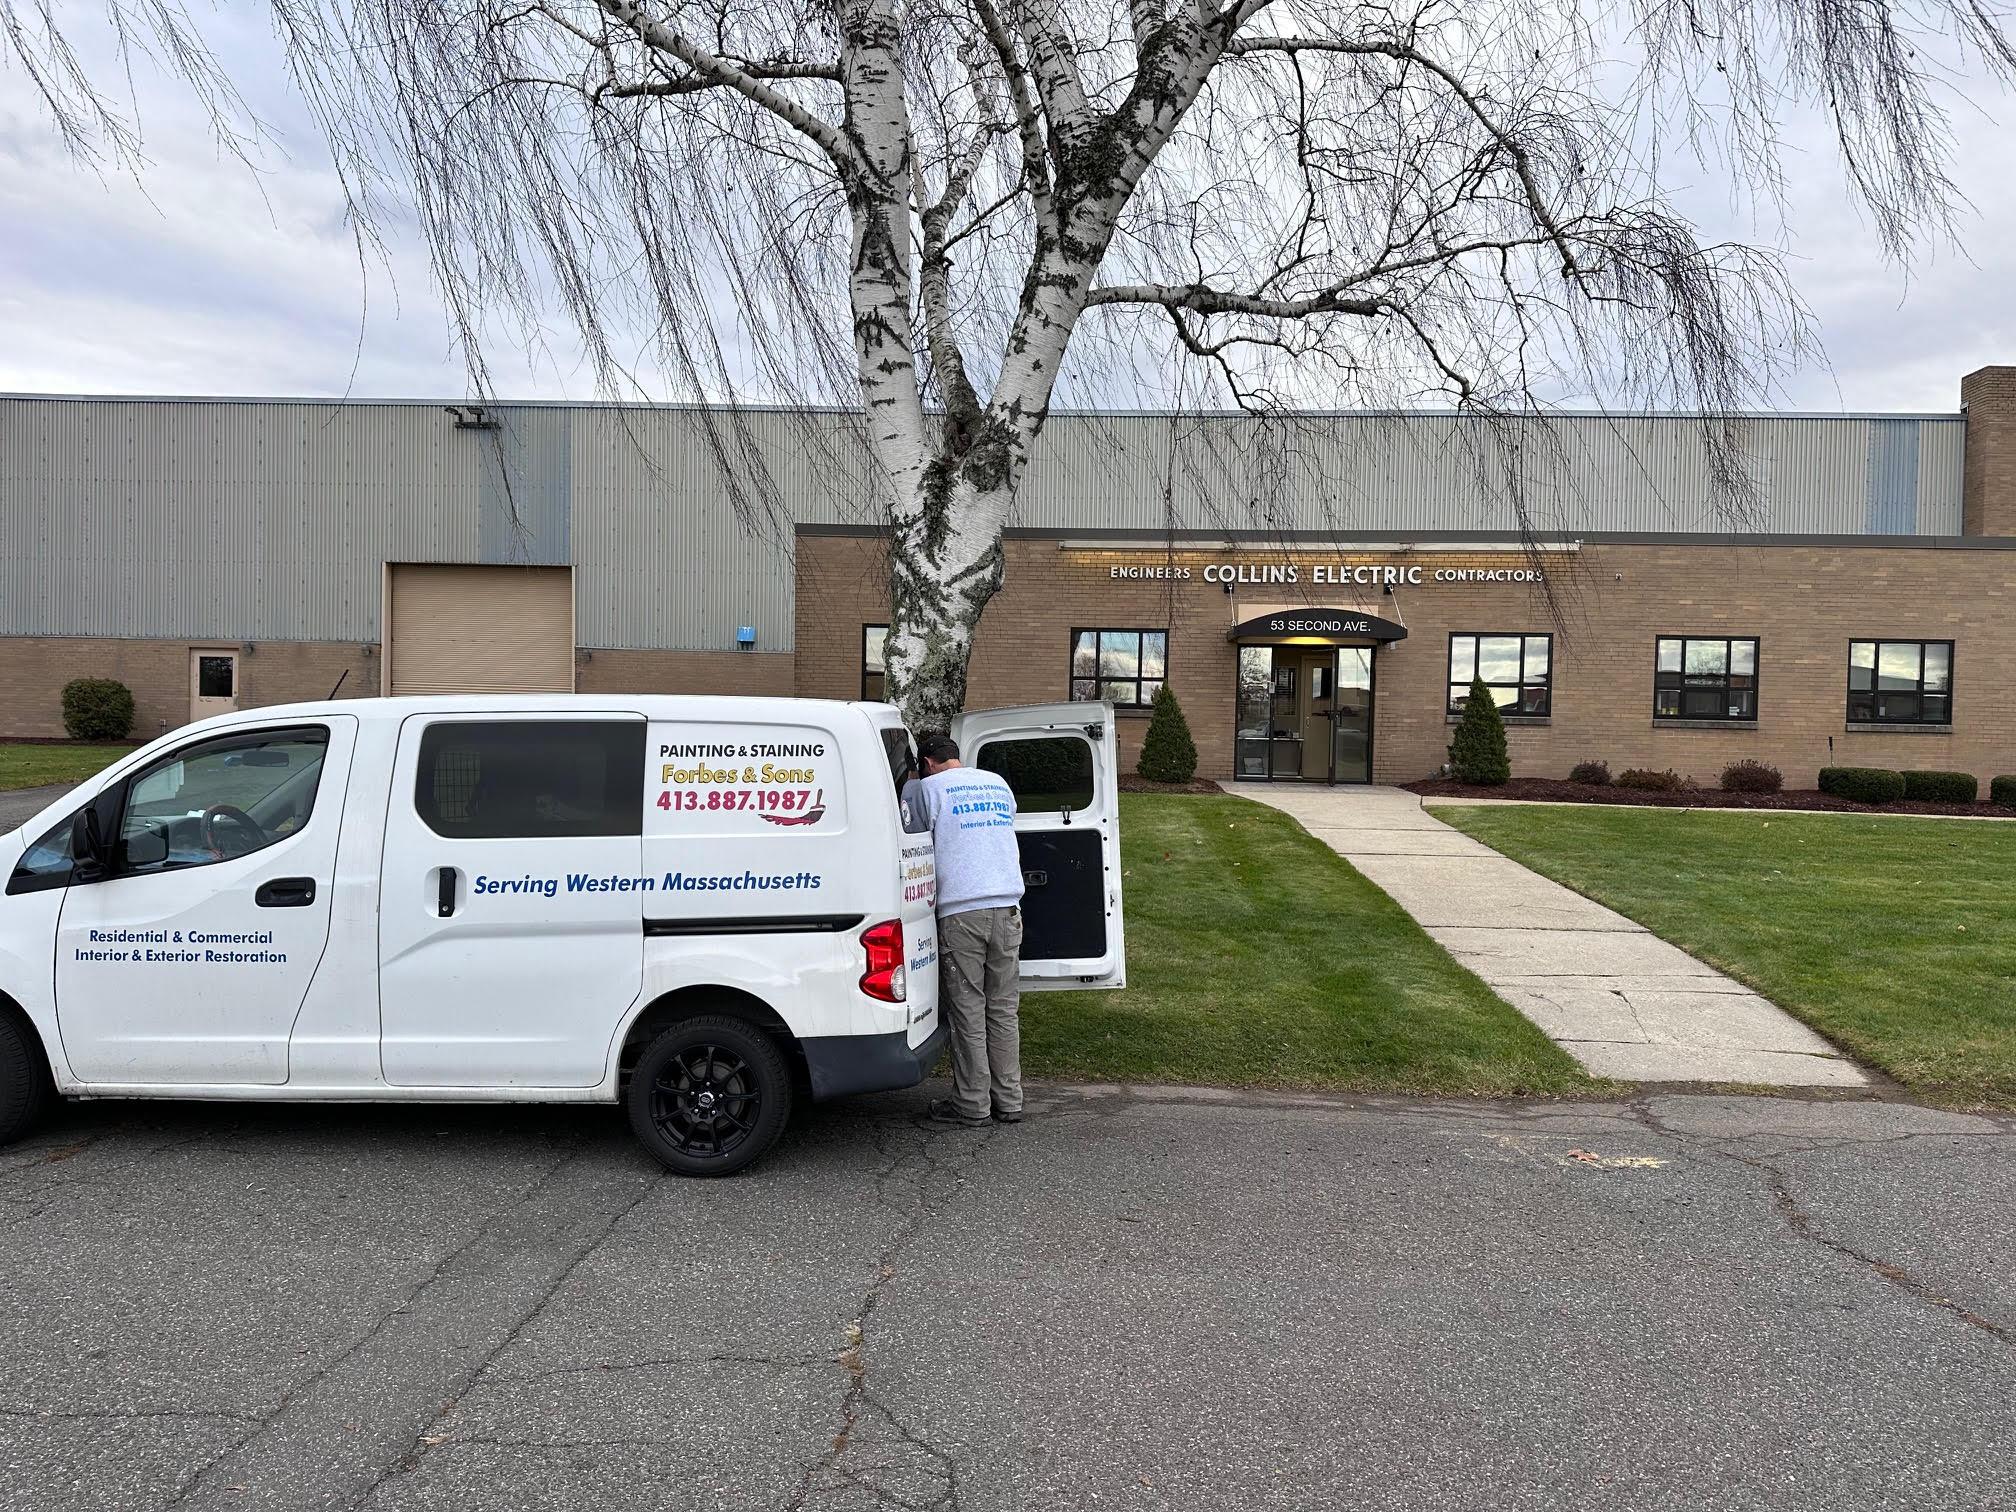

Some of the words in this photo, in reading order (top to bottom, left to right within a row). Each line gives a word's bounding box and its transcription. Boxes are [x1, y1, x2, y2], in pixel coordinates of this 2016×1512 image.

[1110, 567, 1191, 580] ENGINEERS
[1203, 564, 1299, 583] COLLINS
[1312, 565, 1422, 584] ELECTRIC
[1434, 569, 1543, 582] CONTRACTORS
[1270, 620, 1285, 631] 53
[1288, 620, 1341, 632] SECOND
[1343, 621, 1371, 632] AVE.
[660, 744, 735, 757] PAINTING
[738, 745, 748, 757] &
[750, 744, 825, 757] STAINING
[661, 762, 738, 784] Forbes
[742, 766, 757, 784] &
[761, 763, 815, 784] Sons
[945, 785, 979, 795] PAINTING
[656, 790, 811, 811] 413.887.1987
[952, 801, 1010, 816] 413.887.1987
[960, 820, 986, 830] Interior
[986, 819, 992, 827] &
[474, 874, 558, 898] Serving
[566, 873, 655, 892] Western
[662, 871, 821, 890] Massachusetts
[89, 930, 168, 943] Residential
[172, 931, 183, 943] &
[188, 931, 273, 944] Commercial
[75, 949, 129, 962] Interior
[131, 950, 142, 962] &
[146, 949, 201, 962] Exterior
[205, 950, 287, 963] Restoration
